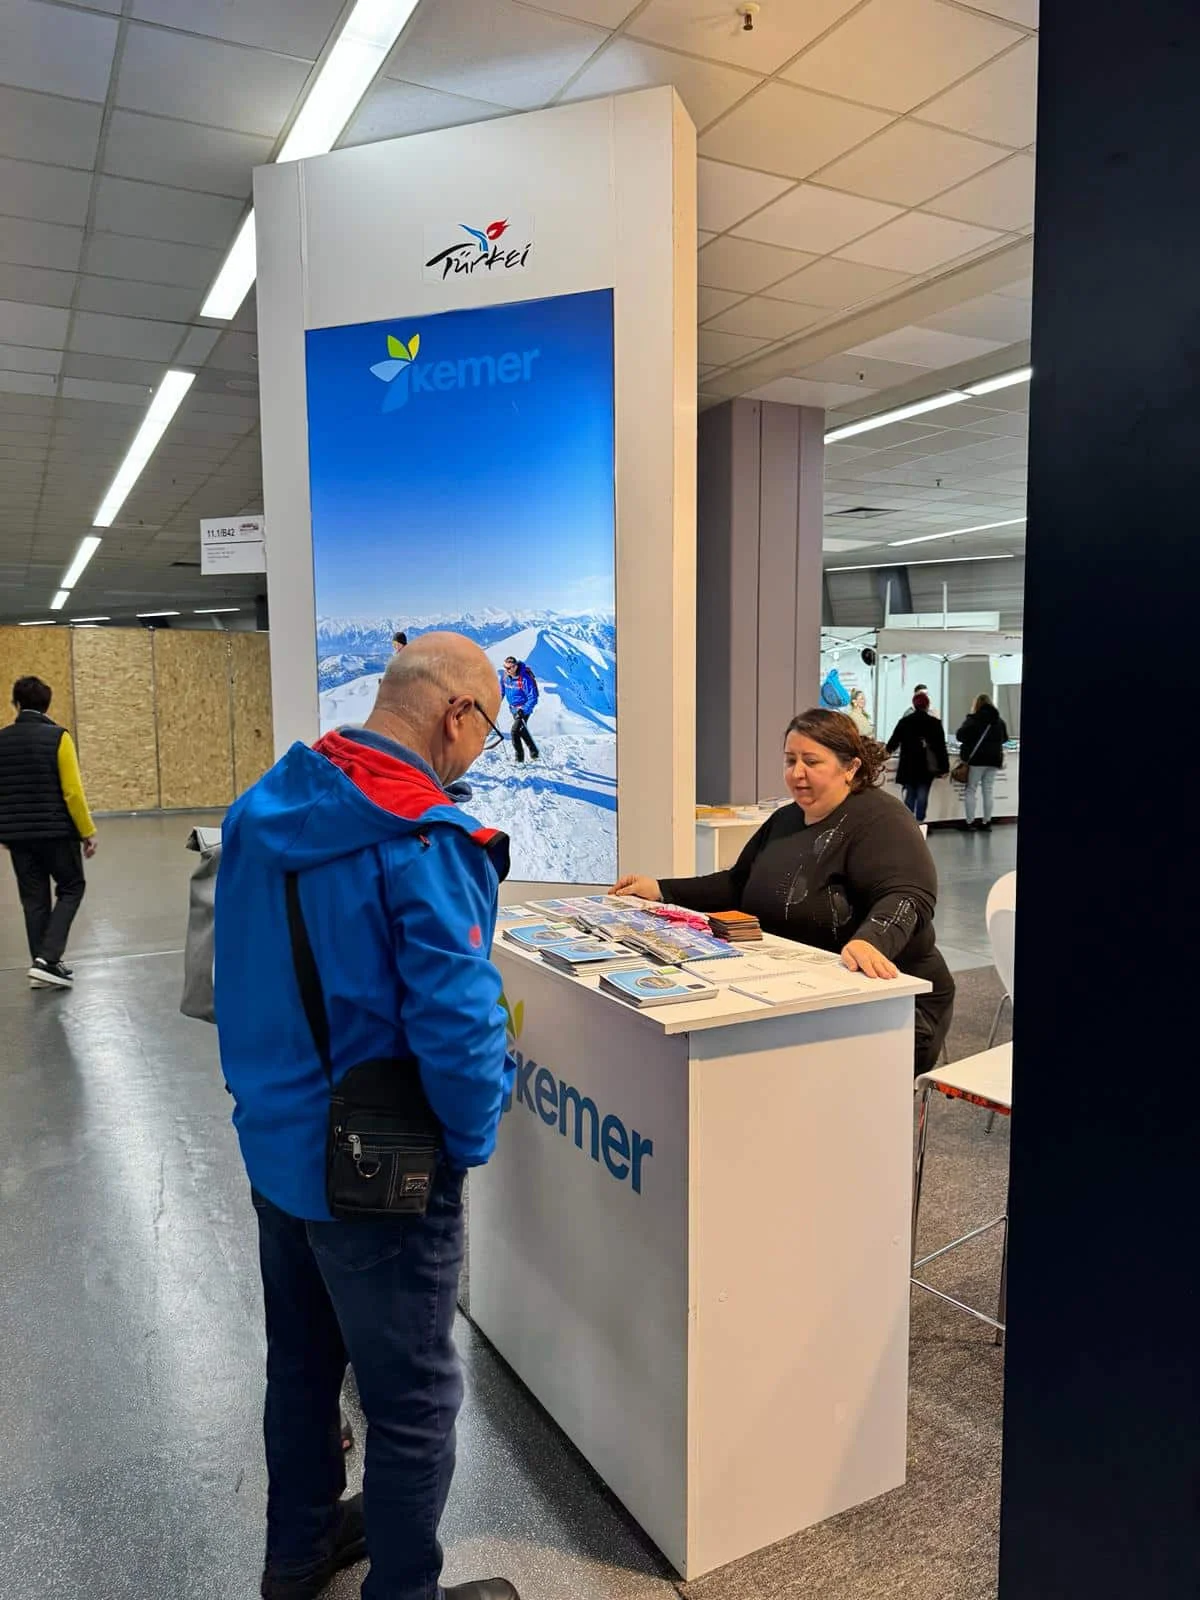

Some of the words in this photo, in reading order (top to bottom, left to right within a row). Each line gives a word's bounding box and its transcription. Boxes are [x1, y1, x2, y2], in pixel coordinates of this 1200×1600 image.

[425, 242, 532, 280] Türkei
[411, 348, 541, 393] kemer
[207, 528, 236, 538] 11.1/B42
[515, 1051, 654, 1195] kemer
